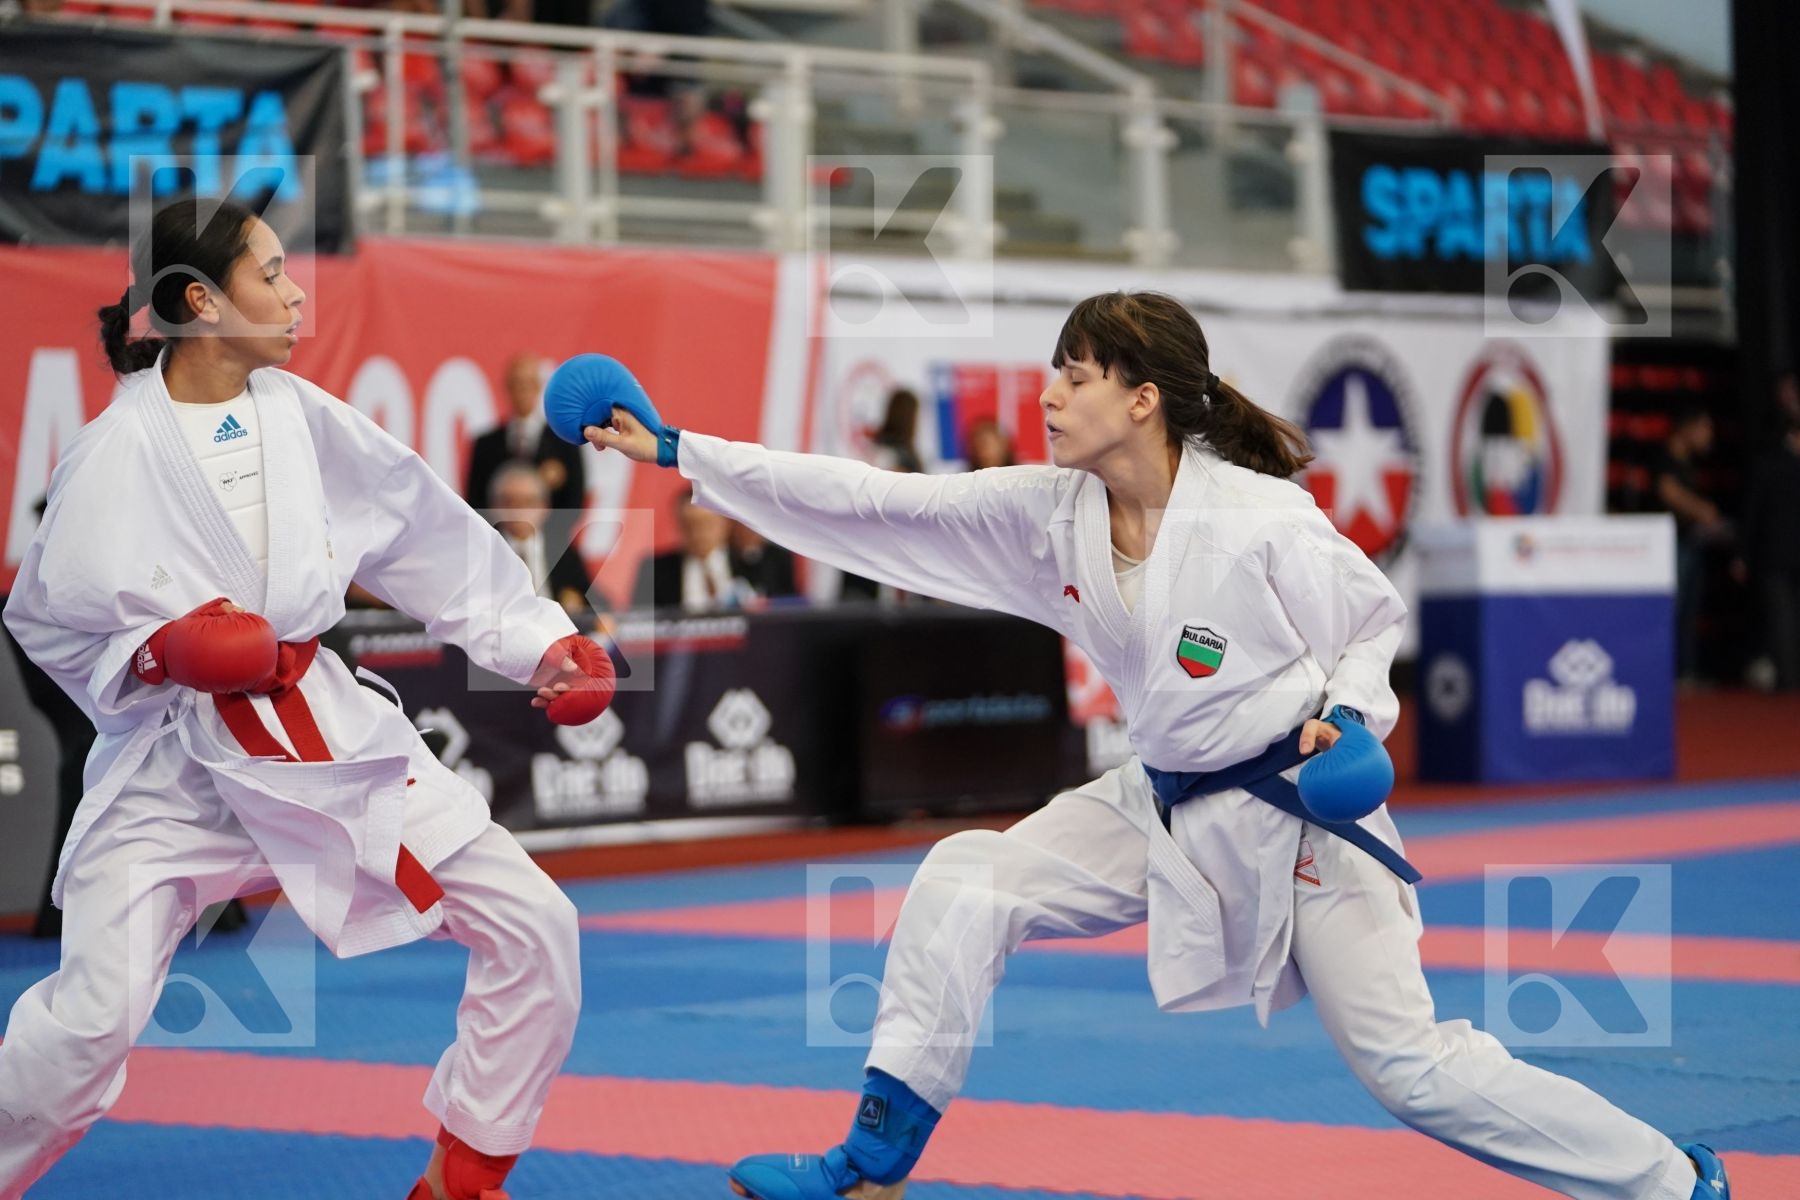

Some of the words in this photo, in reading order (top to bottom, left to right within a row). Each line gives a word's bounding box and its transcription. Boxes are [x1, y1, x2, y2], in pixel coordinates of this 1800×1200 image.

[1361, 163, 1594, 264] SPARTA
[213, 428, 248, 443] adidas
[1182, 629, 1224, 651] BULGARIA
